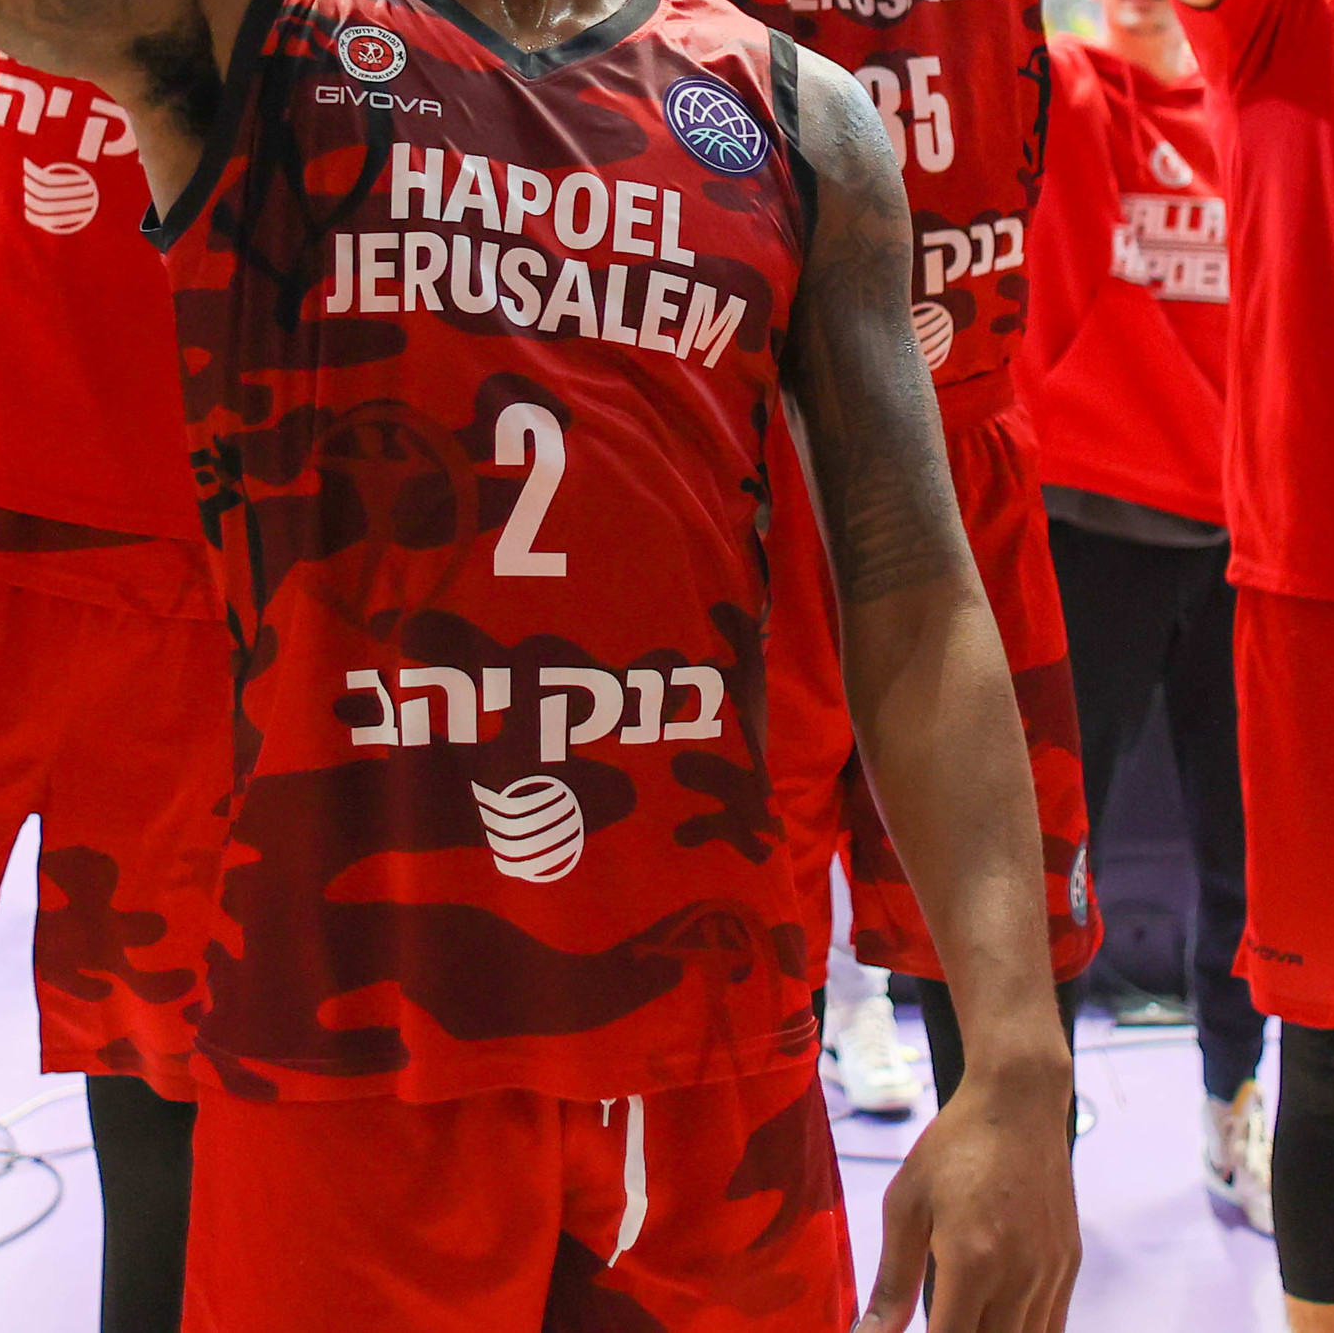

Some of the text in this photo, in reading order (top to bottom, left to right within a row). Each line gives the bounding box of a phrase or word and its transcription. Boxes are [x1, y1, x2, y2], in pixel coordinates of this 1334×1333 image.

[315, 84, 443, 117] GIVOVA
[389, 142, 696, 267] HAPOEL
[922, 217, 1025, 296] בנק
[326, 230, 748, 369] JERUSALEM
[493, 402, 567, 577] 2
[345, 665, 725, 763] בנק יהב
